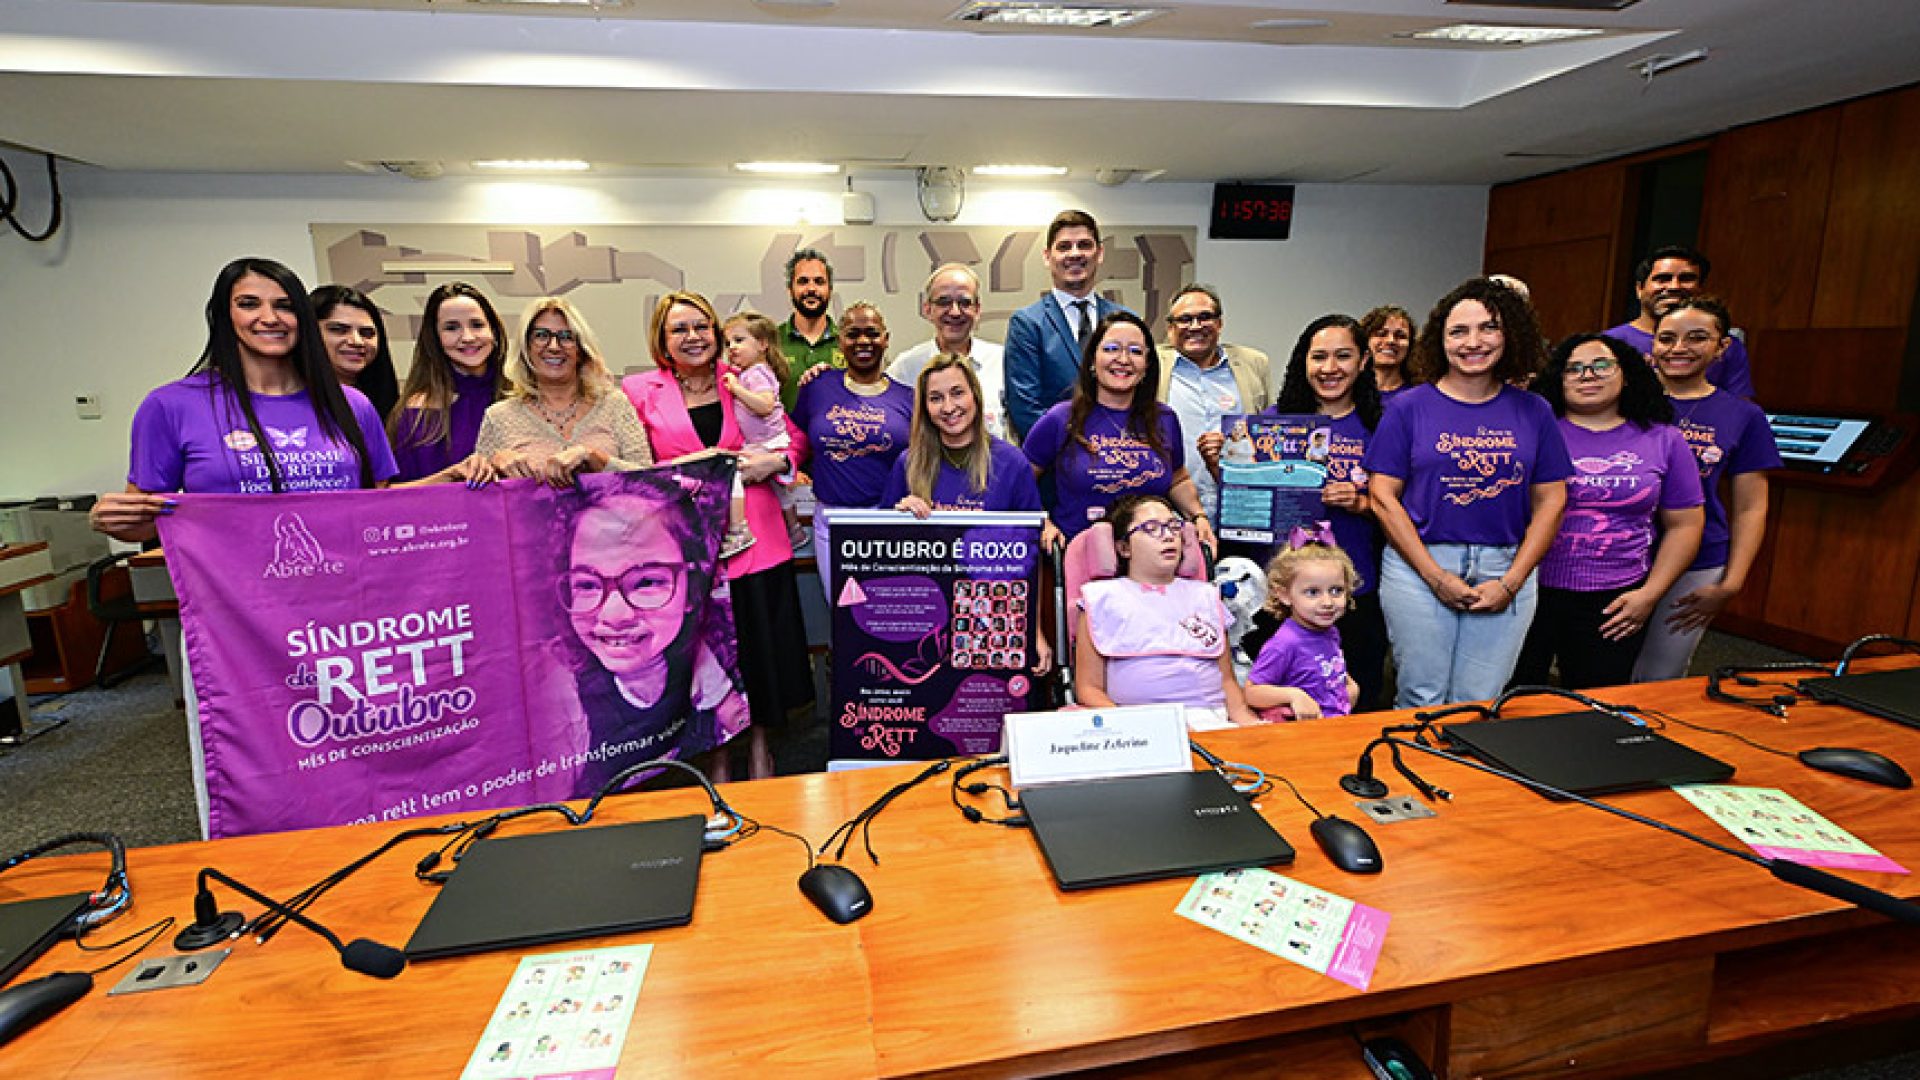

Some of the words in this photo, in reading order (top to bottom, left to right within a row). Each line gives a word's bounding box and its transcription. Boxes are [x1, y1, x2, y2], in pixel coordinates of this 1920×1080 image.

[287, 462, 337, 477] RETT
[841, 540, 947, 559] OUTUBRO
[952, 538, 965, 559] É
[970, 541, 1028, 559] ROXO
[287, 604, 472, 657] SÍNDROME
[316, 631, 474, 704] RETT
[288, 683, 476, 748] Outubro
[839, 702, 926, 728] SÍNDROME
[862, 722, 918, 756] RETT
[299, 752, 326, 770] MÊS
[328, 747, 348, 762] DE
[352, 717, 480, 757] CONSCIENTIZAÇÃO
[383, 797, 417, 822] rett
[422, 789, 460, 810] tem
[465, 784, 479, 798] o
[482, 768, 533, 795] poder
[535, 760, 557, 777] de
[560, 735, 654, 770] transformar
